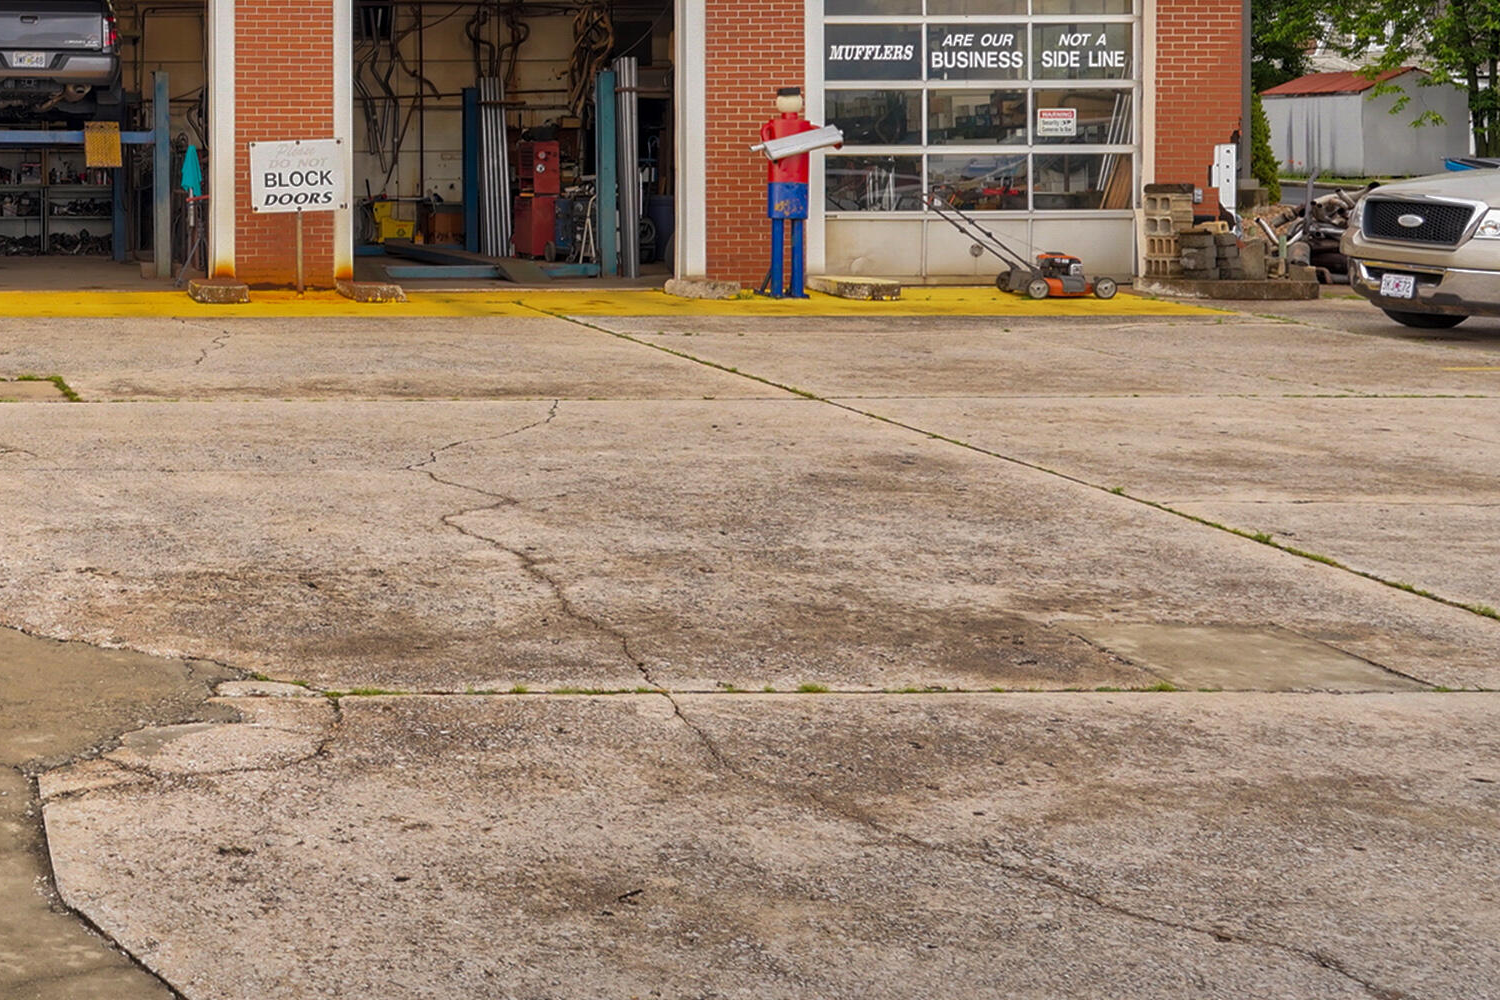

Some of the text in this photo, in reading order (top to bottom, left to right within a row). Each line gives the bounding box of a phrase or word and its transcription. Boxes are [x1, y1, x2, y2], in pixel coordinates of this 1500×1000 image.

[942, 34, 1014, 47] ARE OUR
[1058, 34, 1107, 47] NOT A
[829, 45, 913, 61] MUFFLERS
[931, 51, 1024, 68] BUSINESS
[1041, 51, 1125, 68] SIDE LINE
[269, 158, 329, 169] DO NOT
[264, 170, 334, 188] BLOCK
[264, 191, 333, 206] DOORS
